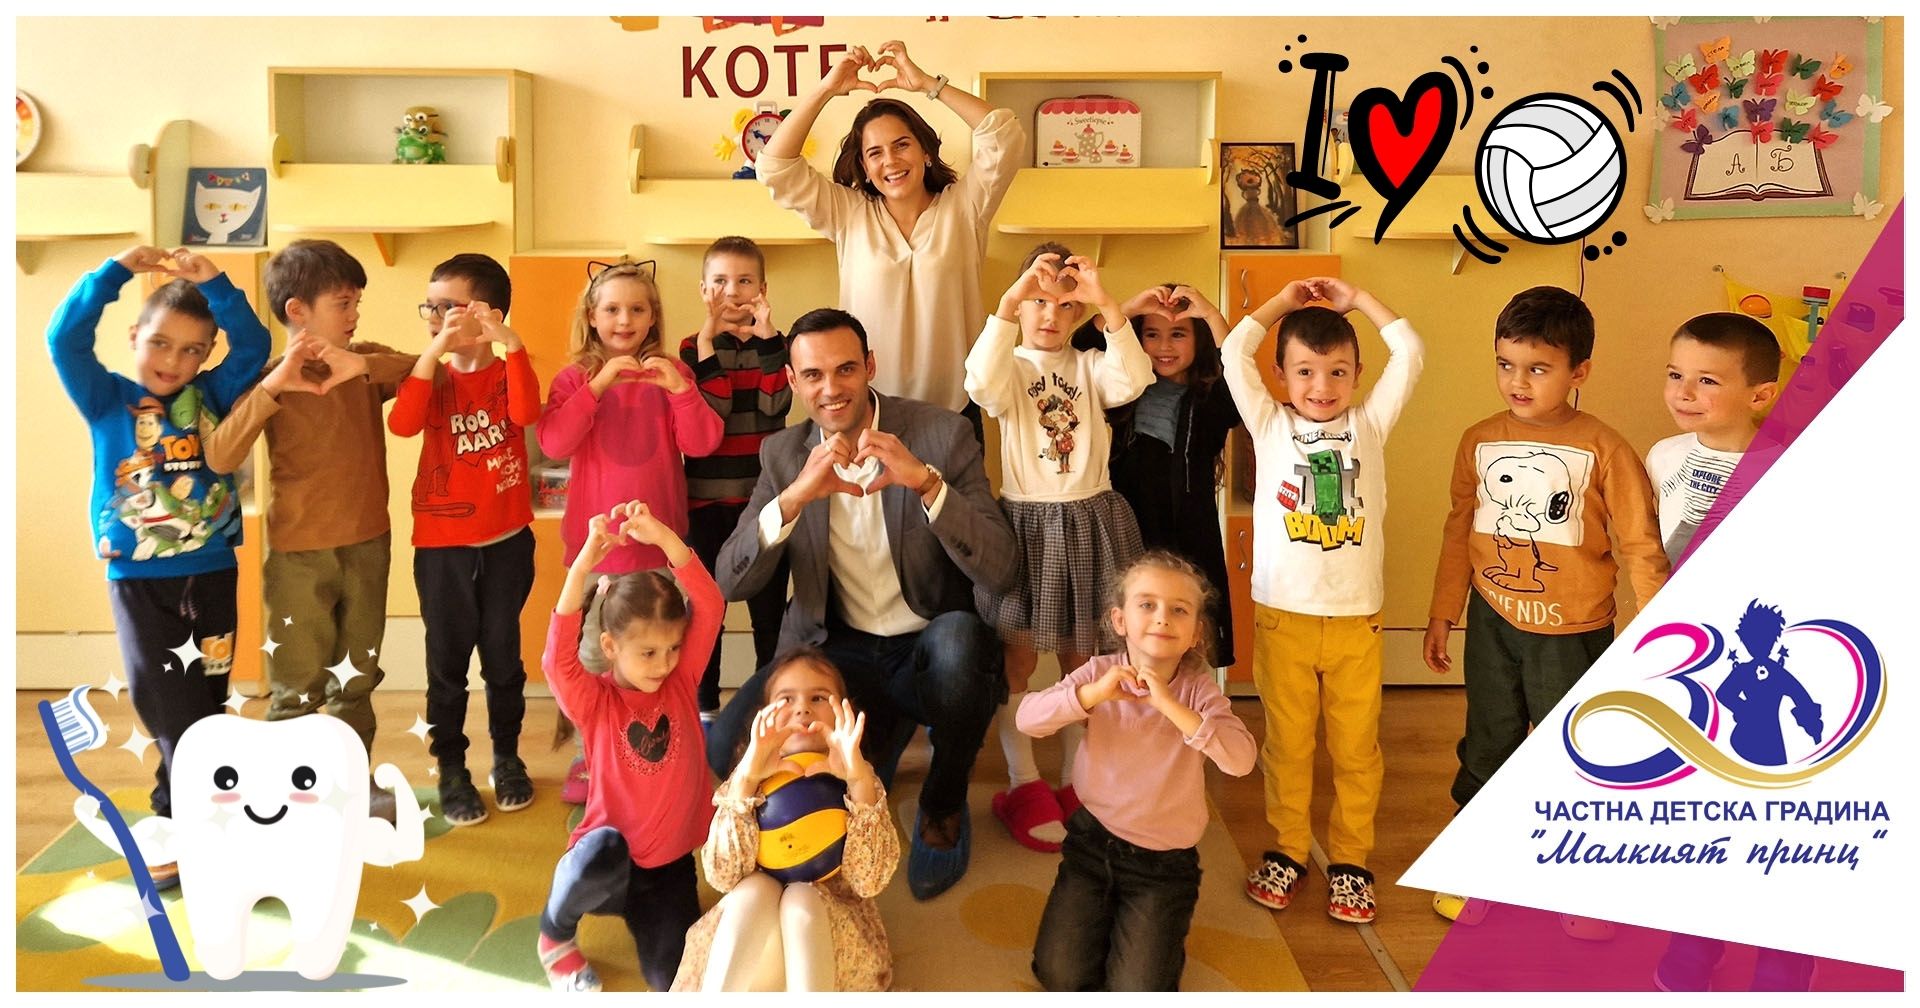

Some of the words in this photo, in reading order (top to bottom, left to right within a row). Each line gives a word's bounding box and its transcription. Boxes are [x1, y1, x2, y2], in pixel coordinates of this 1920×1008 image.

[450, 409, 490, 435] ROO
[1690, 479, 1701, 490] THE
[1701, 483, 1720, 495] CITY
[1692, 468, 1722, 485] EXPLORE
[1284, 511, 1365, 551] BOOM
